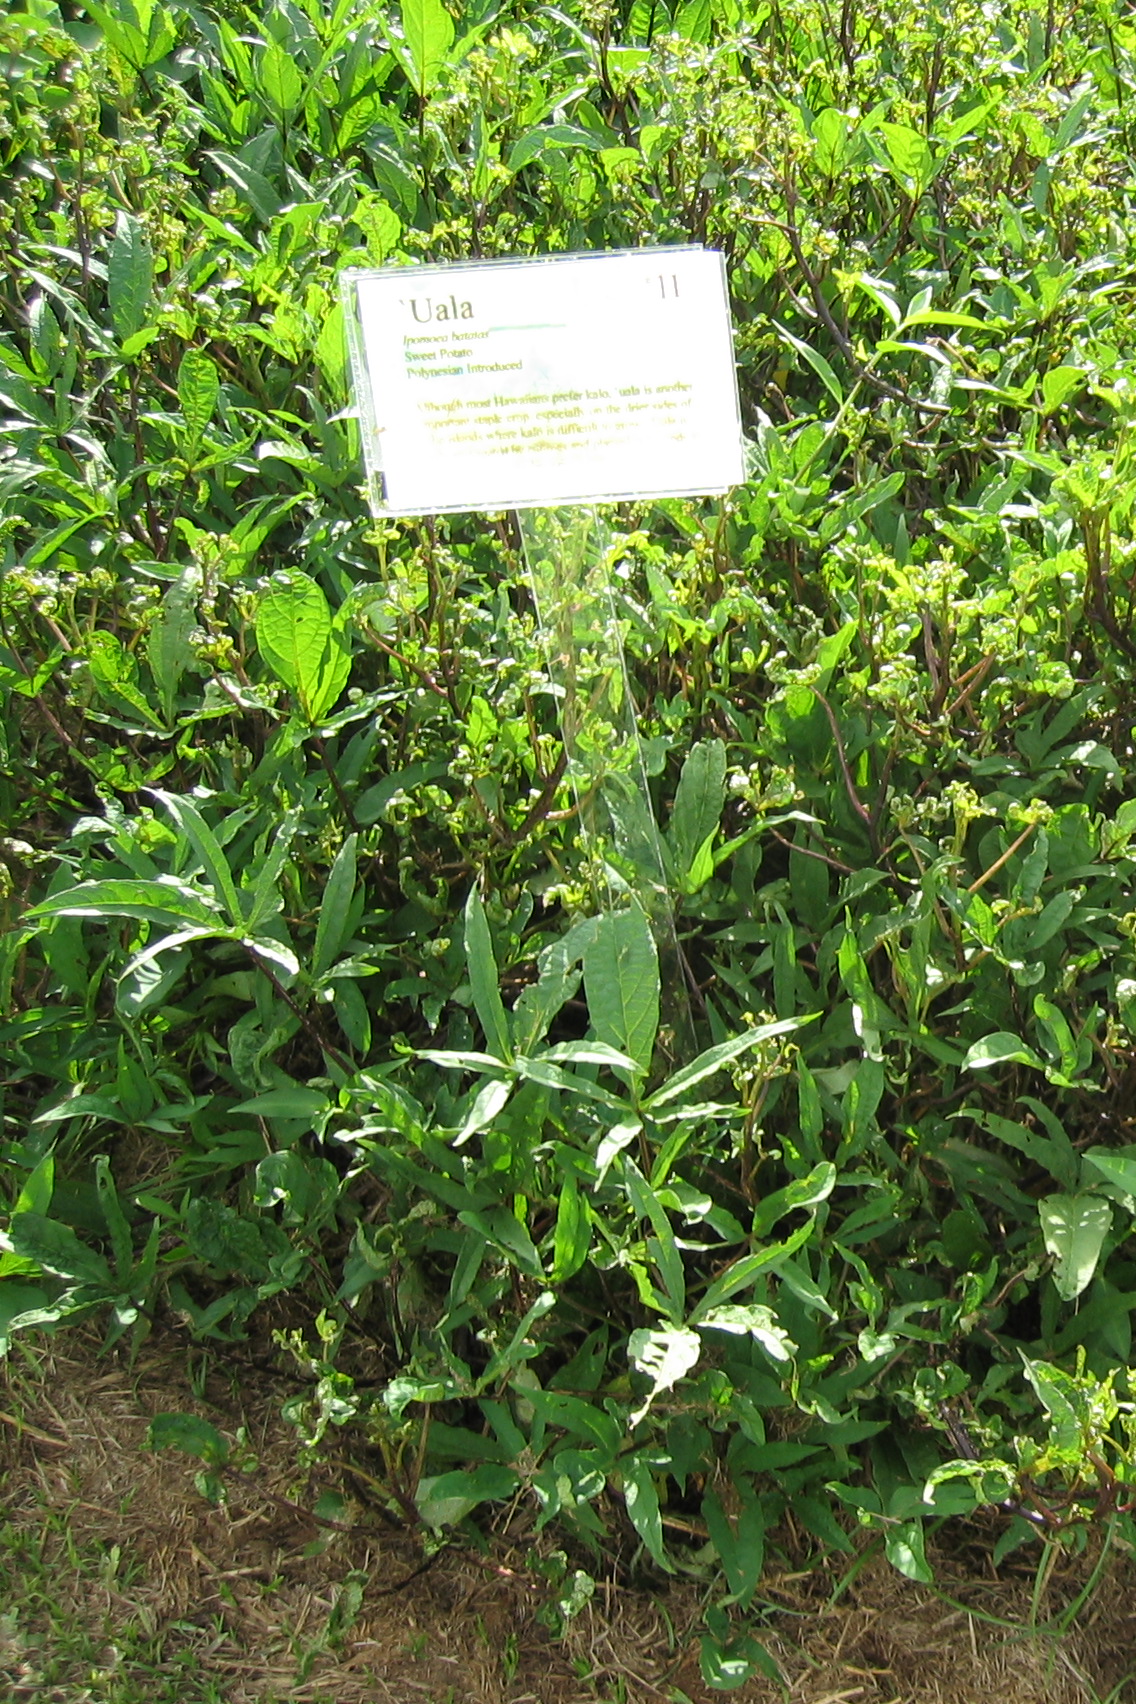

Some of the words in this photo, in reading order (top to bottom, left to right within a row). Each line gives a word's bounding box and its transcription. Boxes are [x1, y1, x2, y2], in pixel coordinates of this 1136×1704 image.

[405, 351, 437, 363] Sweet
[439, 348, 473, 359] Potato
[406, 365, 464, 380] Polynesian
[467, 359, 523, 373] Introduced
[552, 388, 584, 406] prefer
[643, 384, 653, 395] is
